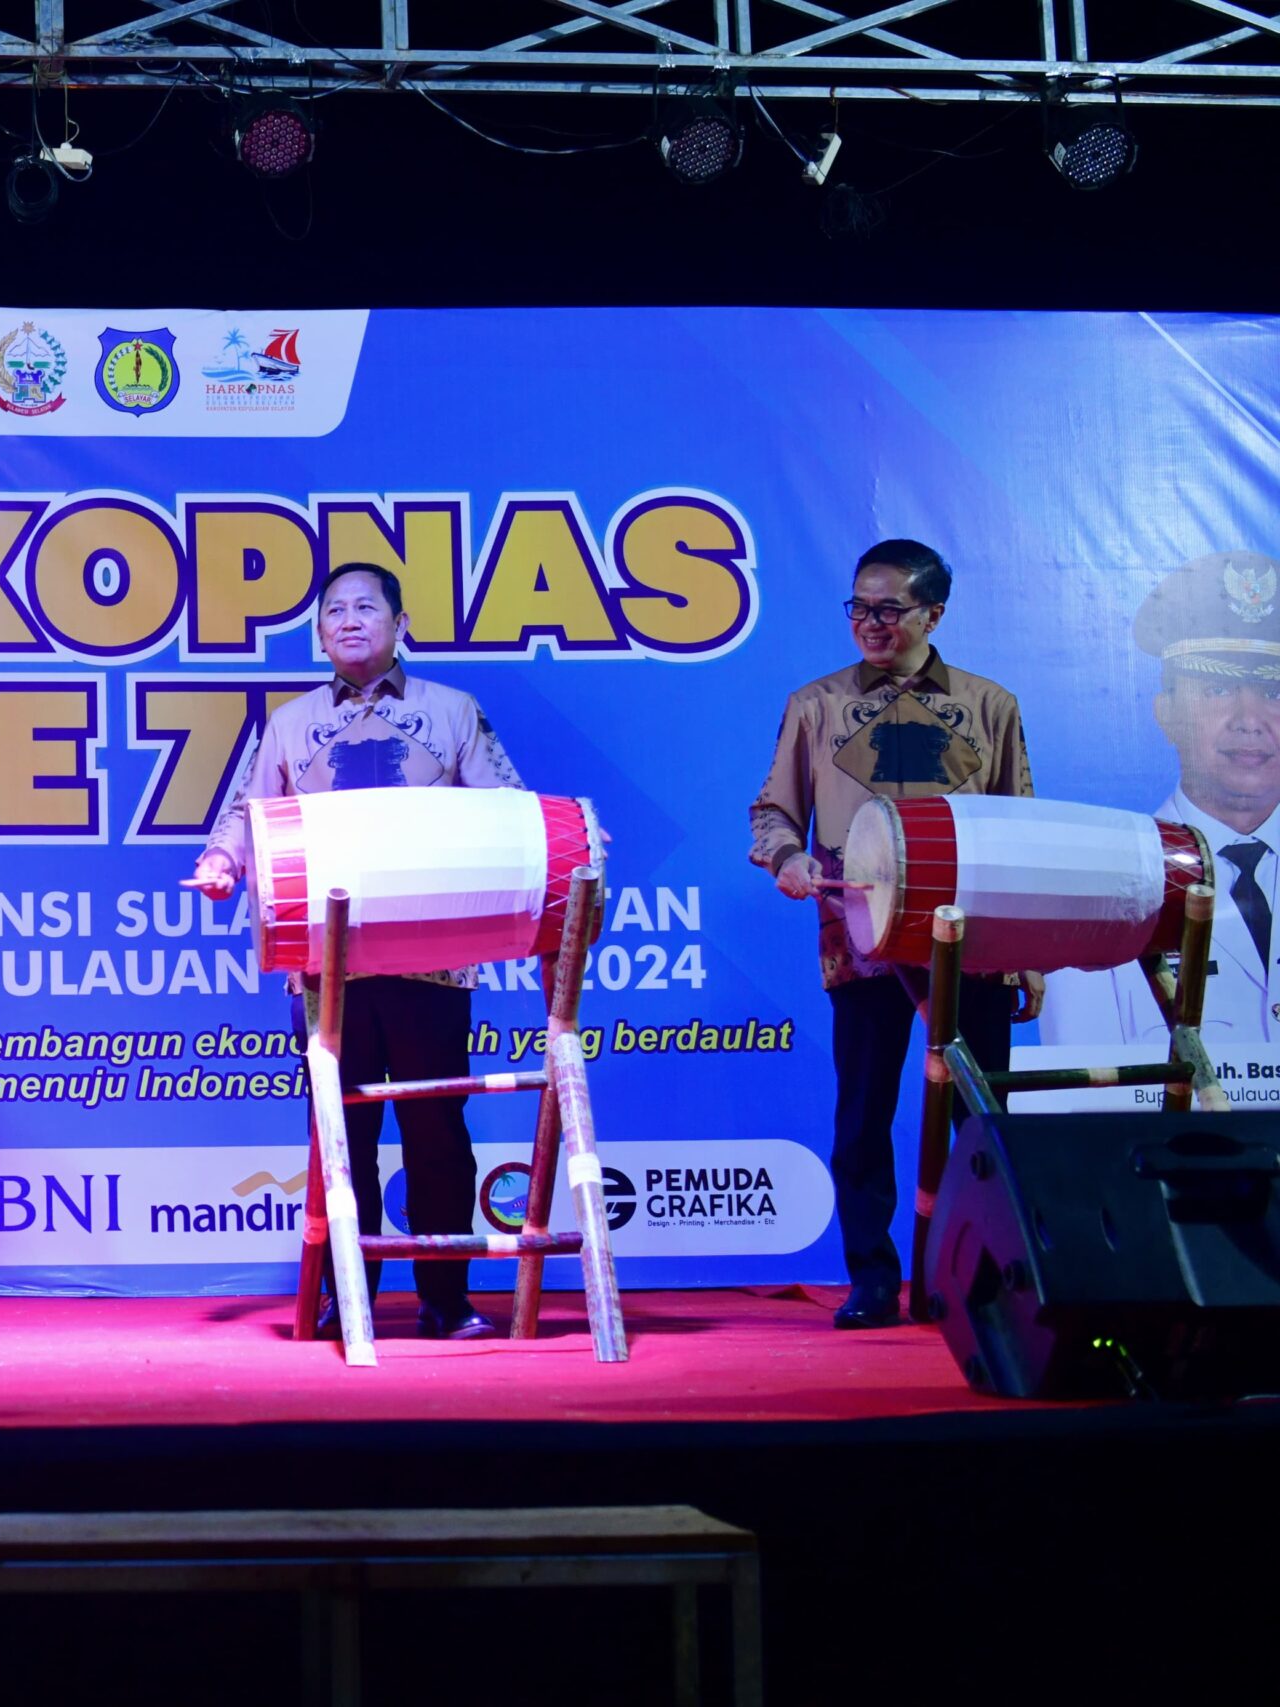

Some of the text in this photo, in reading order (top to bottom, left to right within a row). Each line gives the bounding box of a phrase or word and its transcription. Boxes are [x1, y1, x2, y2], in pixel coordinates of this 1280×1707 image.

[510, 1029, 602, 1060] yag
[613, 1020, 793, 1052] berdaulat
[138, 1066, 308, 1099] Indonesi
[646, 1167, 773, 1191] PEMUDA
[150, 1193, 303, 1233] mandir
[646, 1193, 777, 1218] GRAFIKA
[648, 1217, 775, 1228] Design Printing Merchandise Etc
